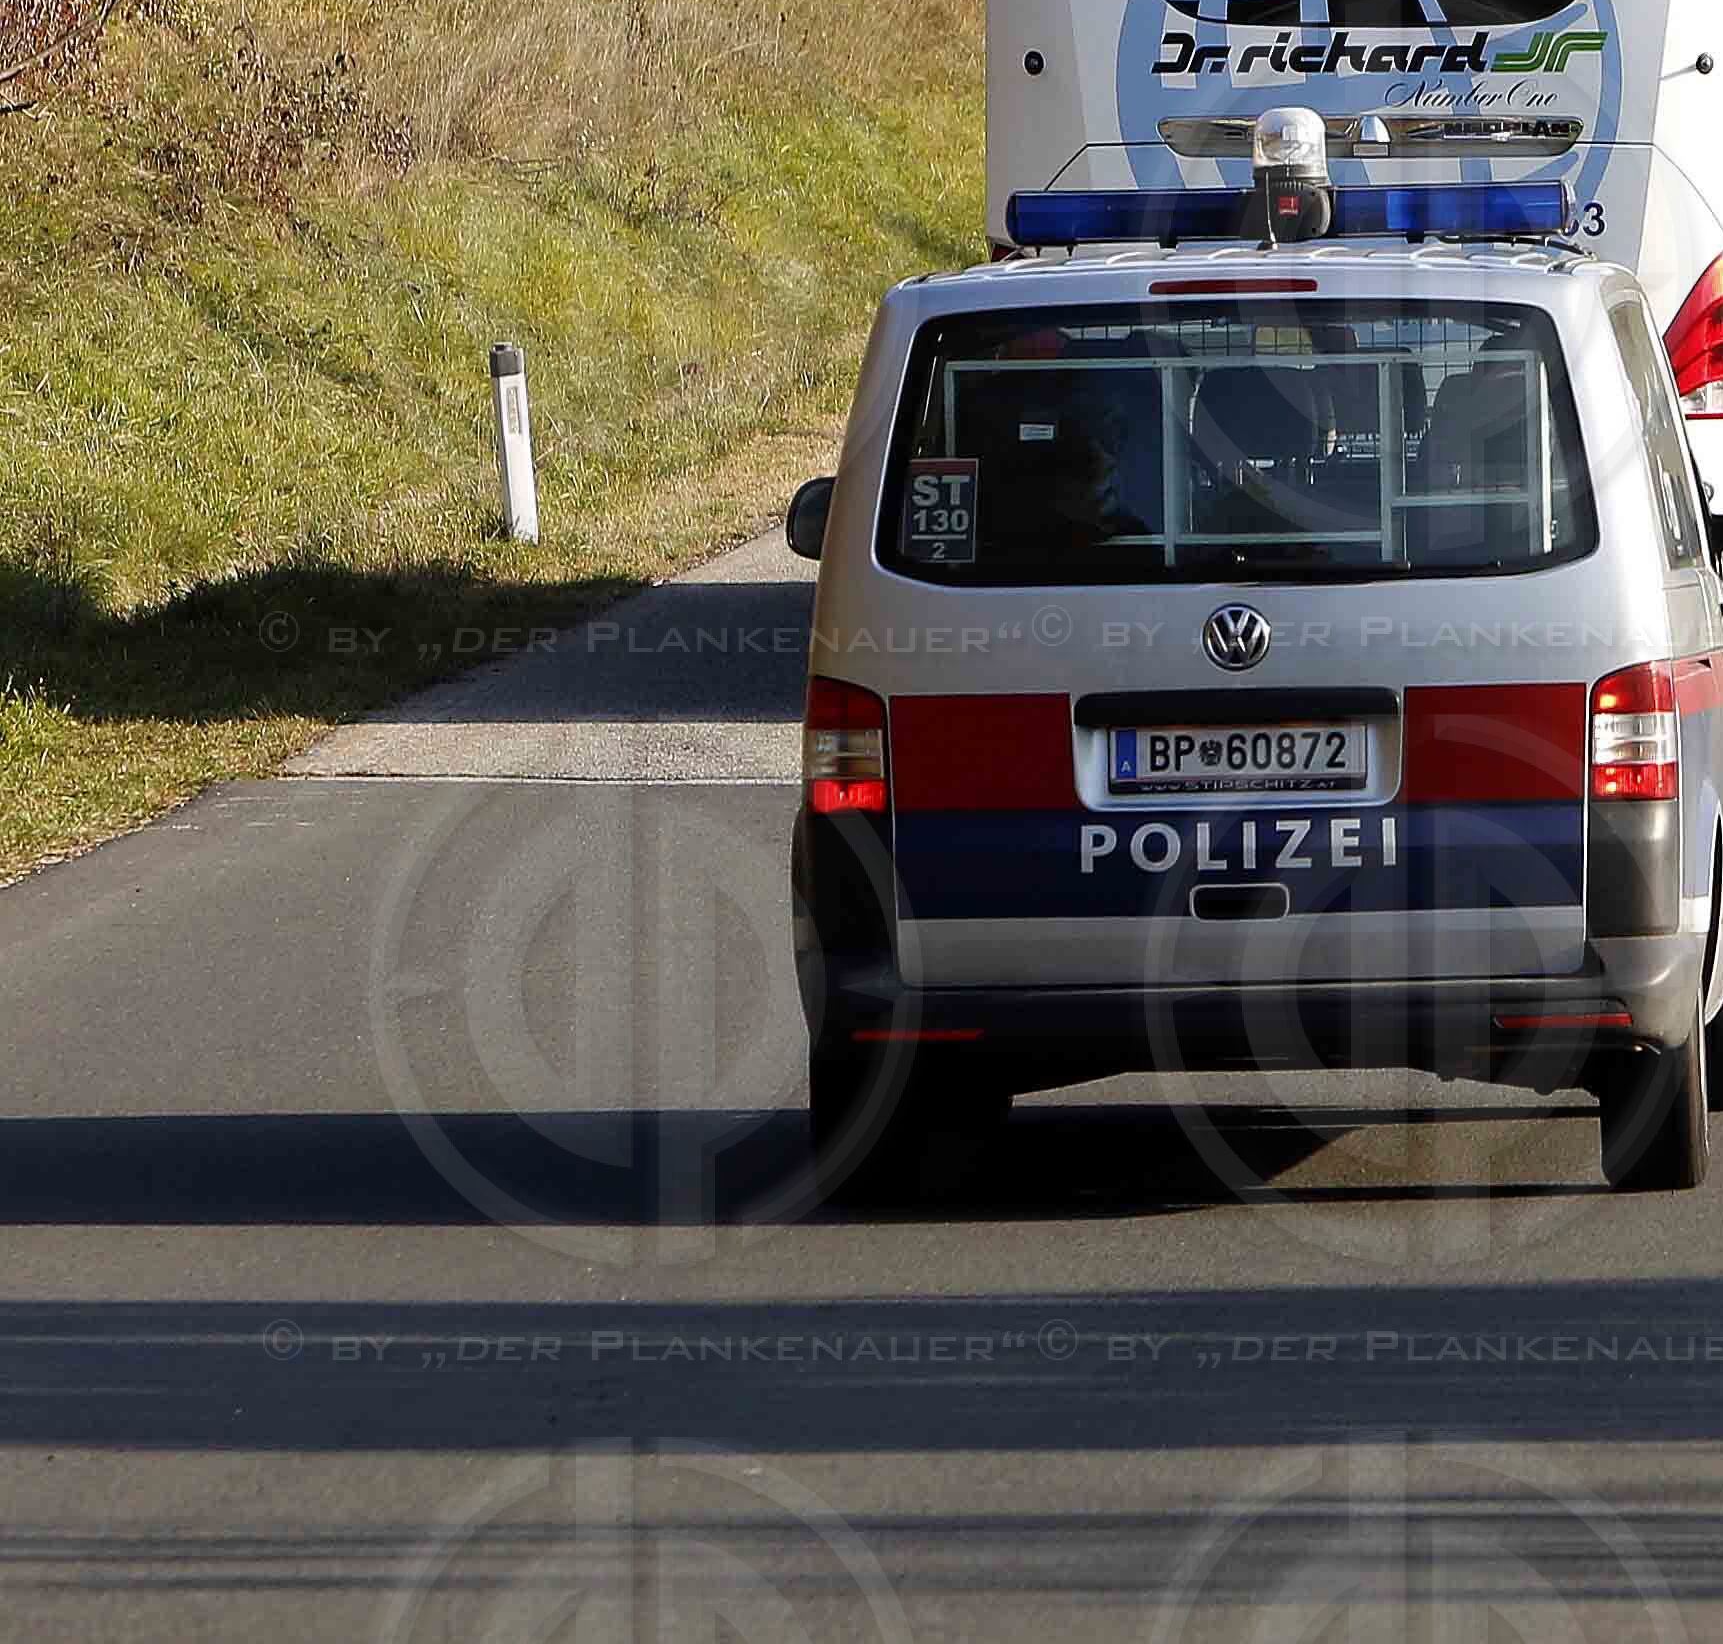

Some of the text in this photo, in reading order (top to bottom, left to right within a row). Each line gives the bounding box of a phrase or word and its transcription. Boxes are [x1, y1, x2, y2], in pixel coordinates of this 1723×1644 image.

[1235, 31, 1494, 73] richard
[1385, 80, 1558, 109] Number One
[911, 475, 970, 506] ST
[913, 509, 969, 532] 130
[932, 542, 945, 559] 2
[1120, 760, 1131, 773] A
[1149, 732, 1346, 772] BP 60872
[1080, 817, 1397, 874] POLIZEI
